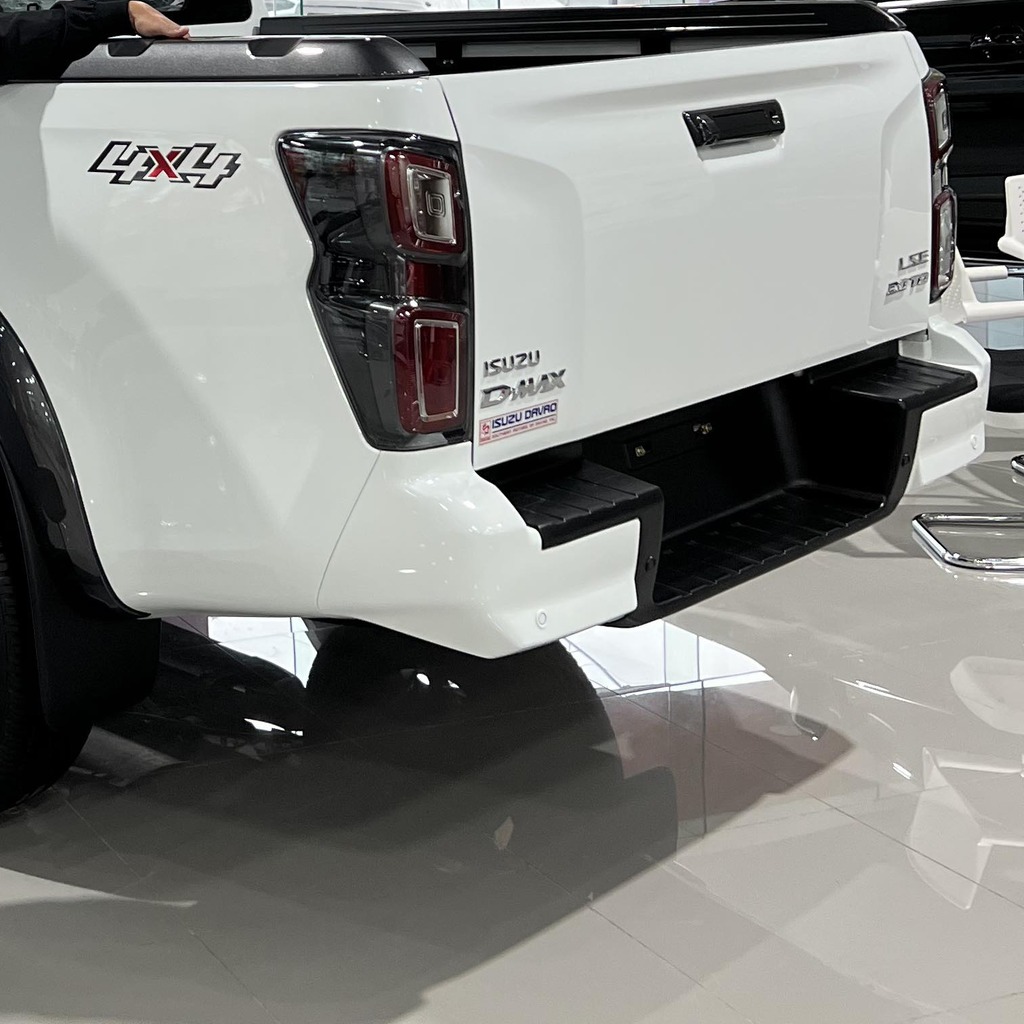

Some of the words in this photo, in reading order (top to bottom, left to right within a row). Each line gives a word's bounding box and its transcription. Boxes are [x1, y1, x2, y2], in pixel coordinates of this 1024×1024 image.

[483, 350, 540, 378] ISUZU
[492, 412, 522, 429] ISUZU
[525, 403, 557, 420] DAVAO
